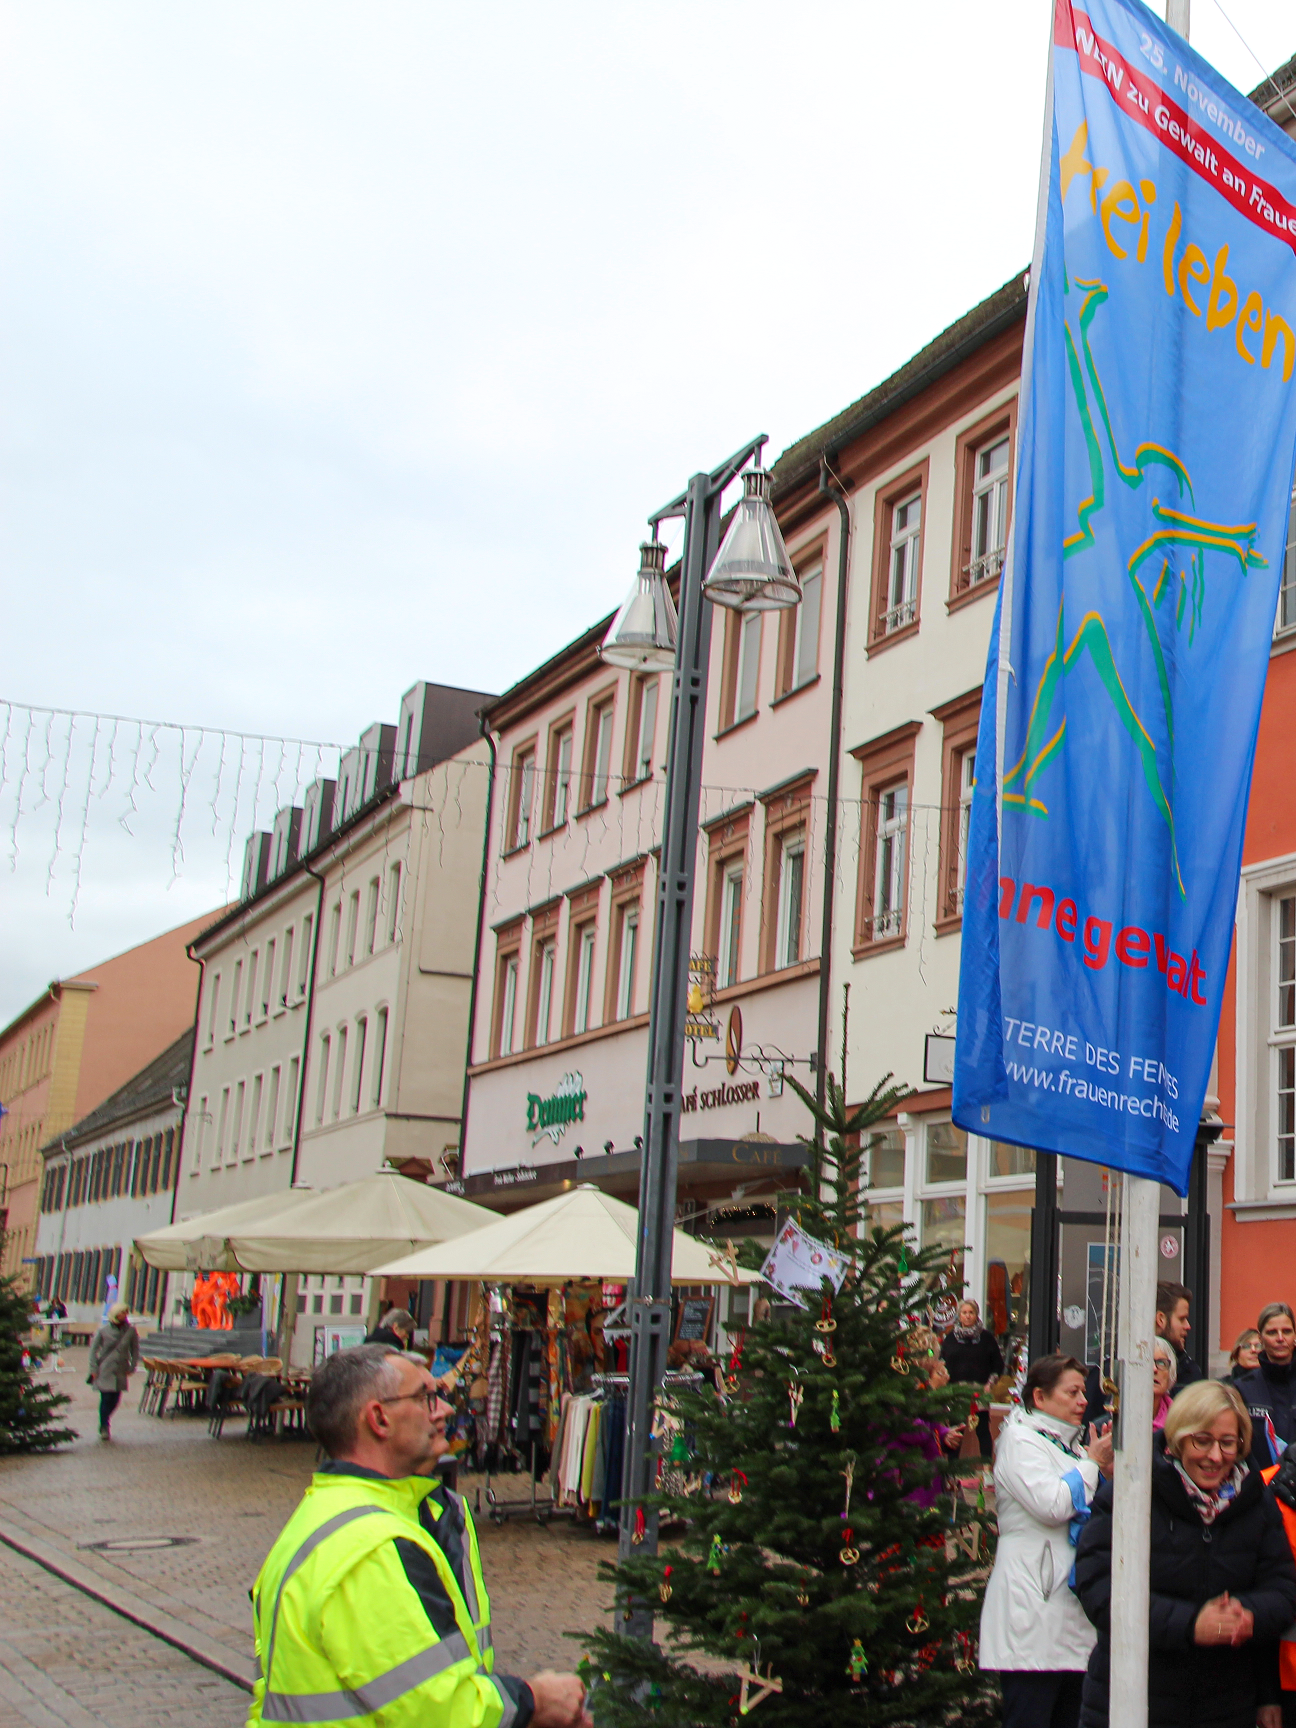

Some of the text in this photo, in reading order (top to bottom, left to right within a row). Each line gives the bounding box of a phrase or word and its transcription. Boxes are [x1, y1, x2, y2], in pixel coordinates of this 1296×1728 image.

[1126, 81, 1150, 115] zu
[1153, 104, 1219, 177] Gewalt
[1221, 165, 1246, 198] an
[1139, 32, 1266, 160] 25. November
[1162, 200, 1296, 383] leben
[684, 1023, 718, 1038] OTEL
[1004, 1015, 1079, 1061] TERRE
[1085, 1041, 1121, 1076] DES
